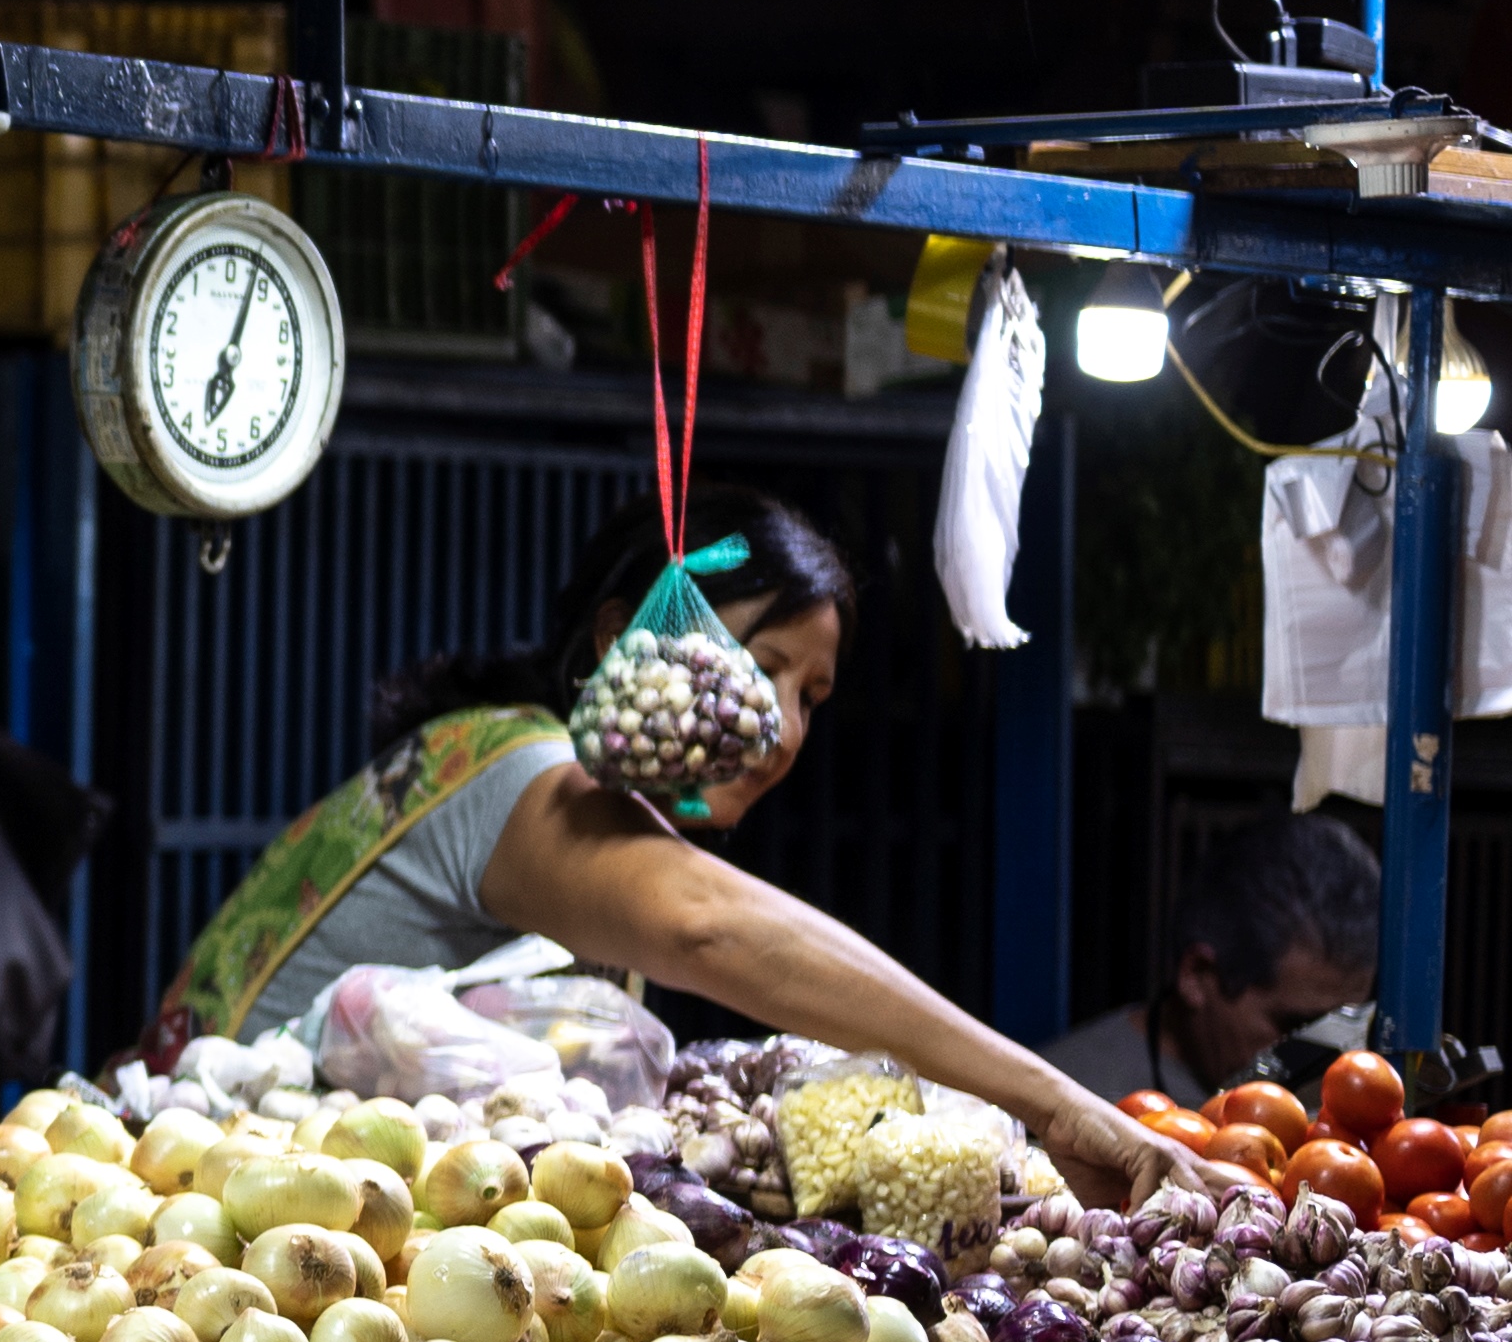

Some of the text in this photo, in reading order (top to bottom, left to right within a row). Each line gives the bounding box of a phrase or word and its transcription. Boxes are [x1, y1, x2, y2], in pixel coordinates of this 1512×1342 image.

[225, 258, 236, 283] 0
[193, 271, 198, 296] 1
[257, 277, 268, 302] 9
[166, 310, 178, 336] 2
[279, 319, 289, 345] 8
[163, 363, 174, 388] 3
[280, 377, 288, 402] 7
[181, 411, 192, 435] 4
[249, 415, 261, 440] 6
[216, 427, 227, 453] 5
